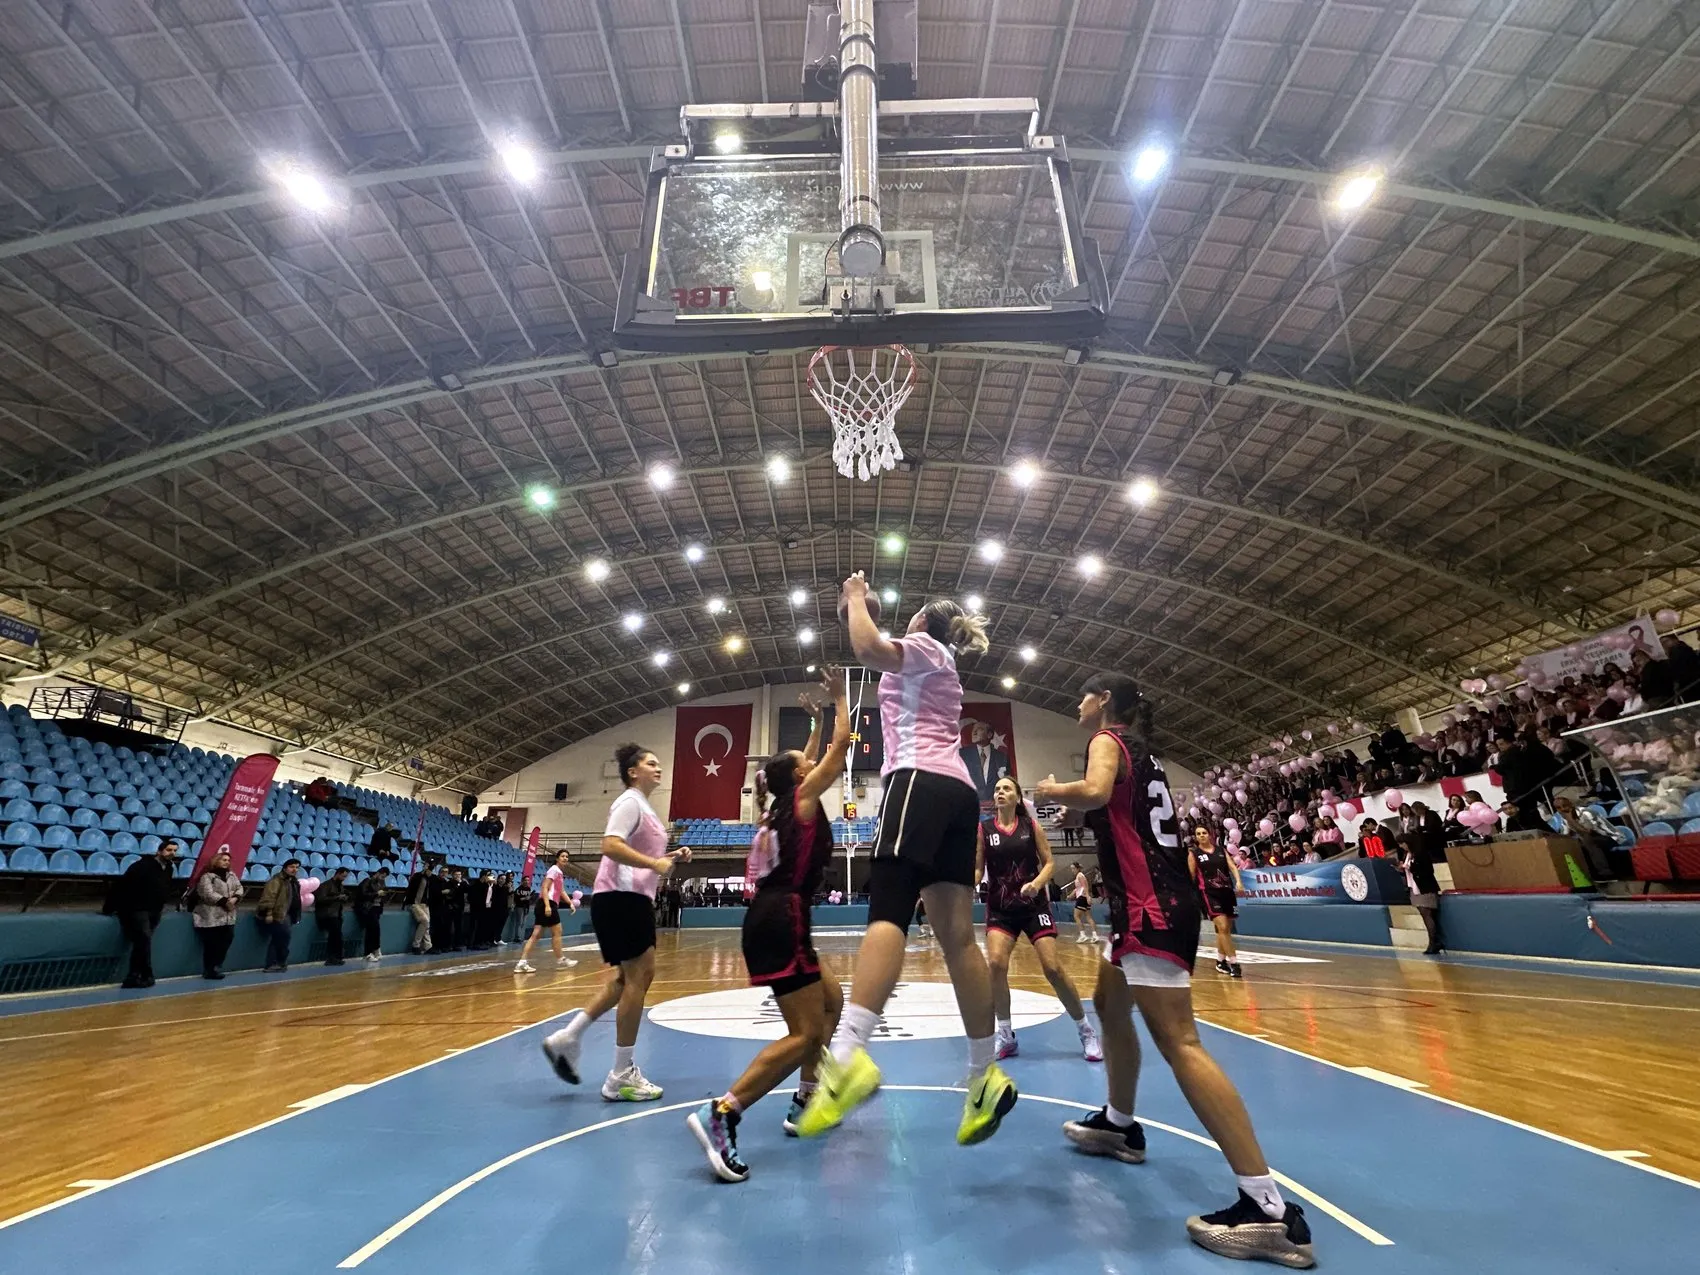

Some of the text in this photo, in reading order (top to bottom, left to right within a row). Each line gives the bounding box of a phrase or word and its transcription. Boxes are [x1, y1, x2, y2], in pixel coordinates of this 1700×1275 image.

[863, 743, 870, 754] 0
[989, 833, 1001, 847] 18
[1256, 871, 1298, 884] EDİRNE
[1037, 913, 1052, 927] 18
